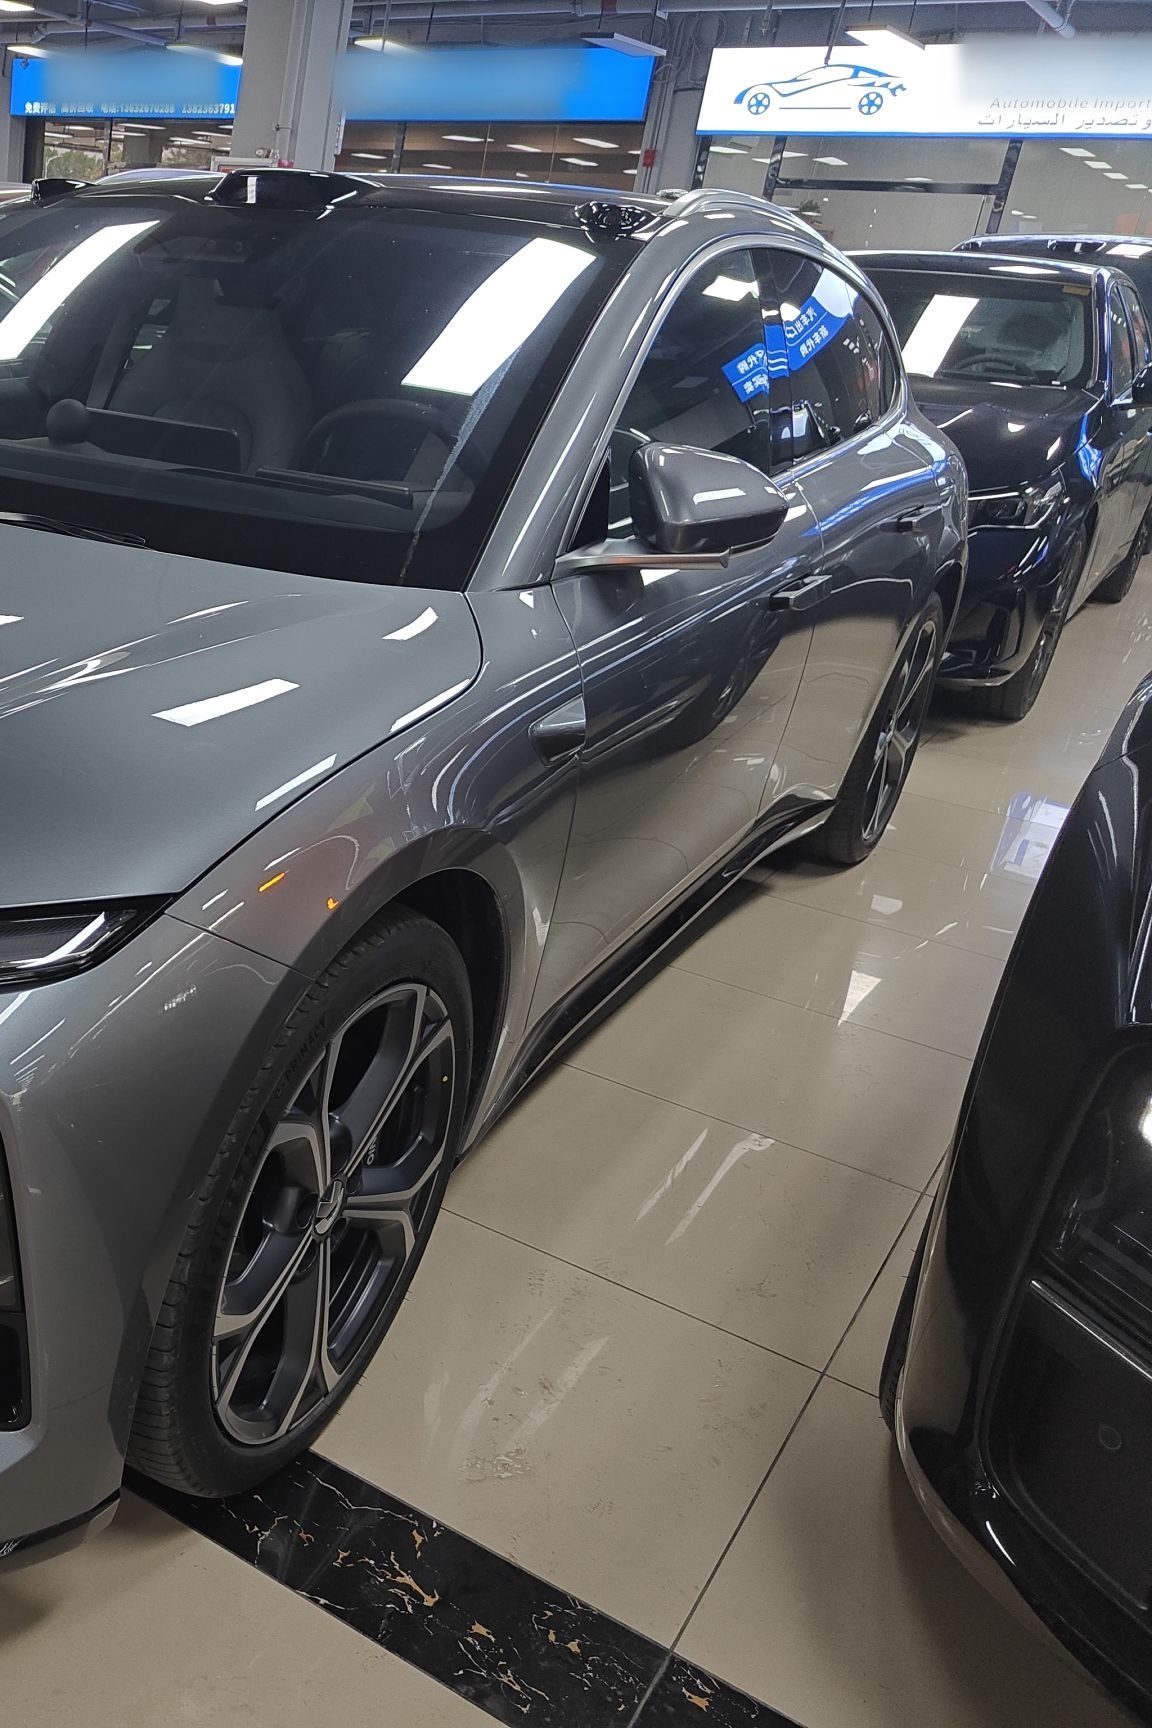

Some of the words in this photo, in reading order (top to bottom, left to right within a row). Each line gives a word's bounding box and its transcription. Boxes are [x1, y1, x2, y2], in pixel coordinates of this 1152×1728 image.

[24, 101, 56, 114] 免费评估
[990, 97, 1089, 109] Automobile
[978, 113, 1066, 130] السيارات
